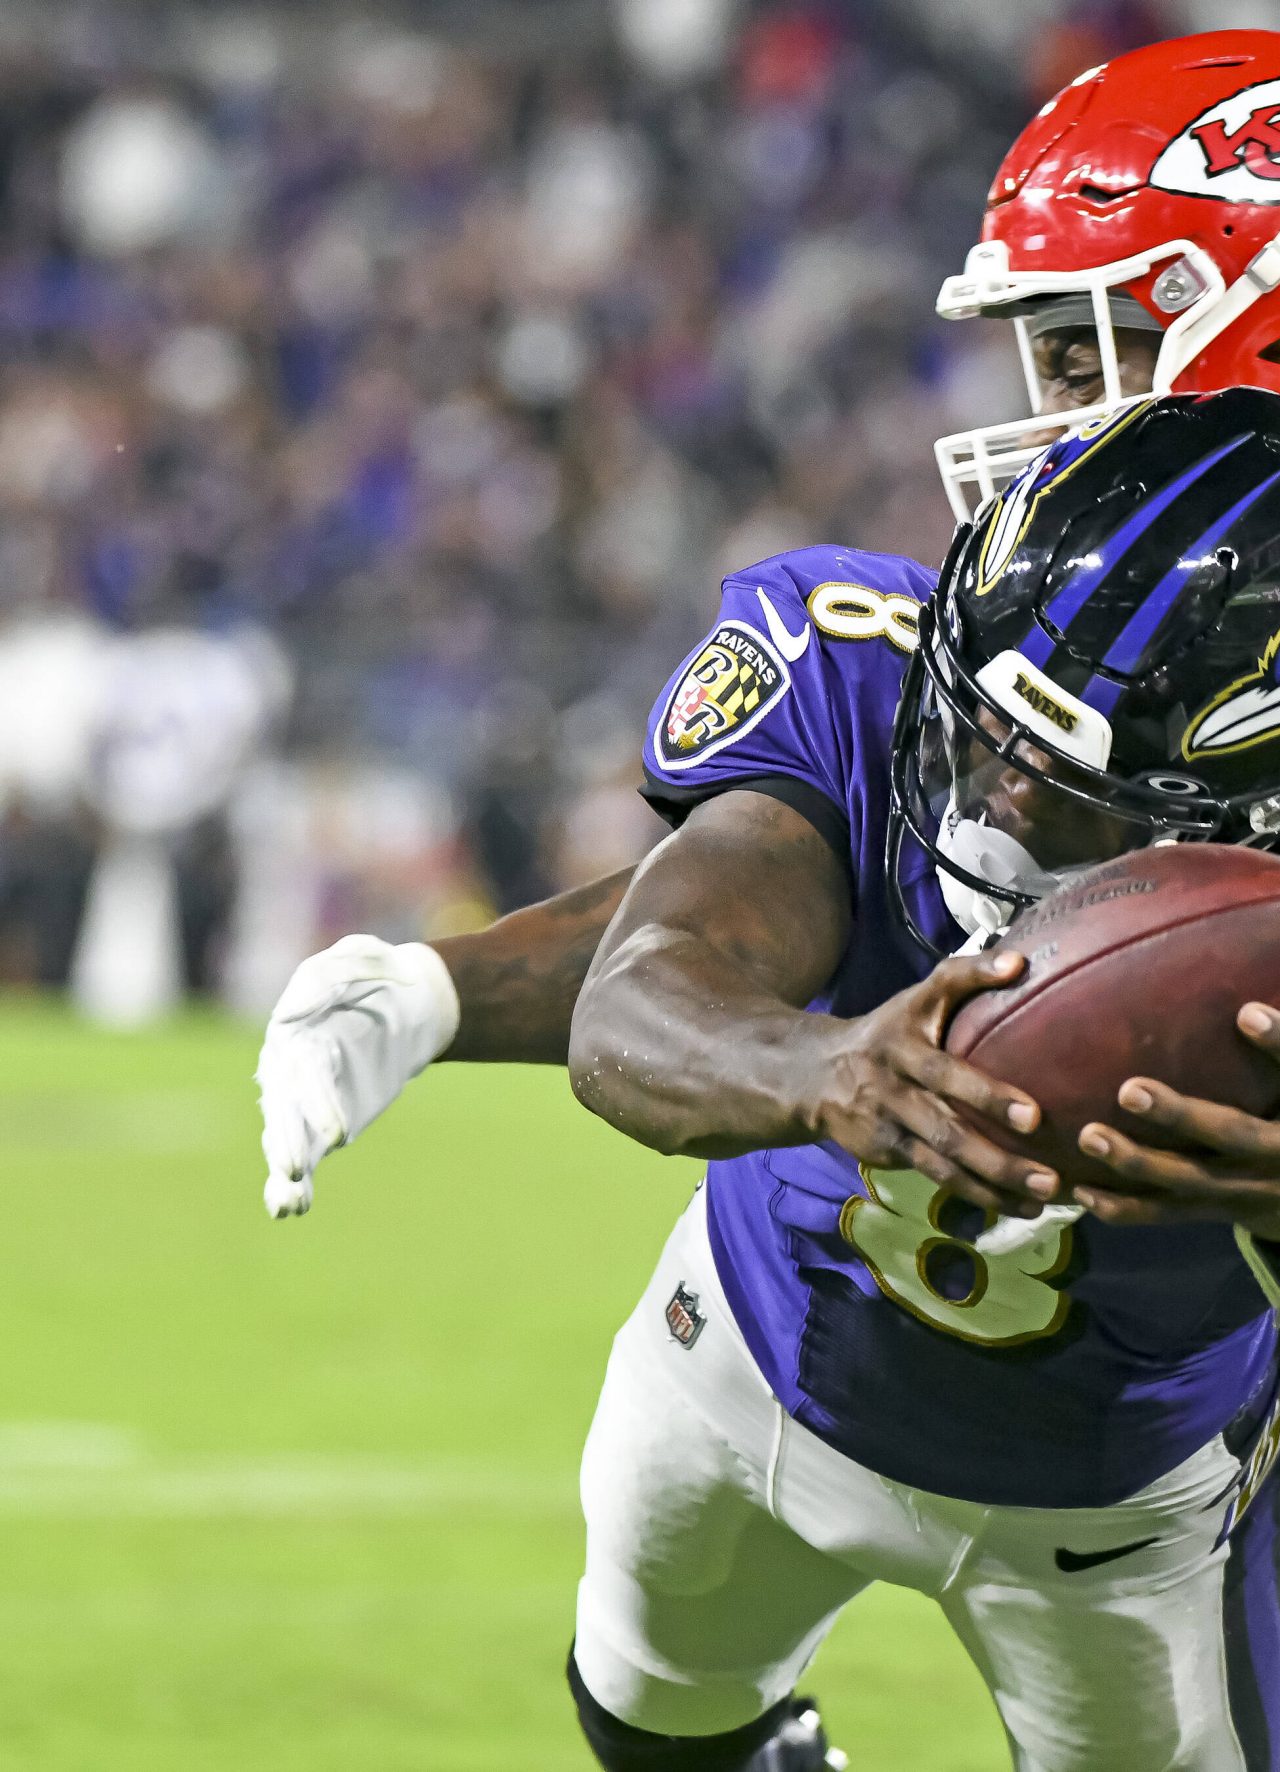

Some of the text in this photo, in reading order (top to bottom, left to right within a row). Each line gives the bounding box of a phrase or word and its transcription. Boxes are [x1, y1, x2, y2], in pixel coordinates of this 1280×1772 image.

[806, 581, 921, 655] 8
[715, 631, 778, 686] RAVENS
[1012, 671, 1081, 733] RAVENS
[839, 1162, 1074, 1347] 8
